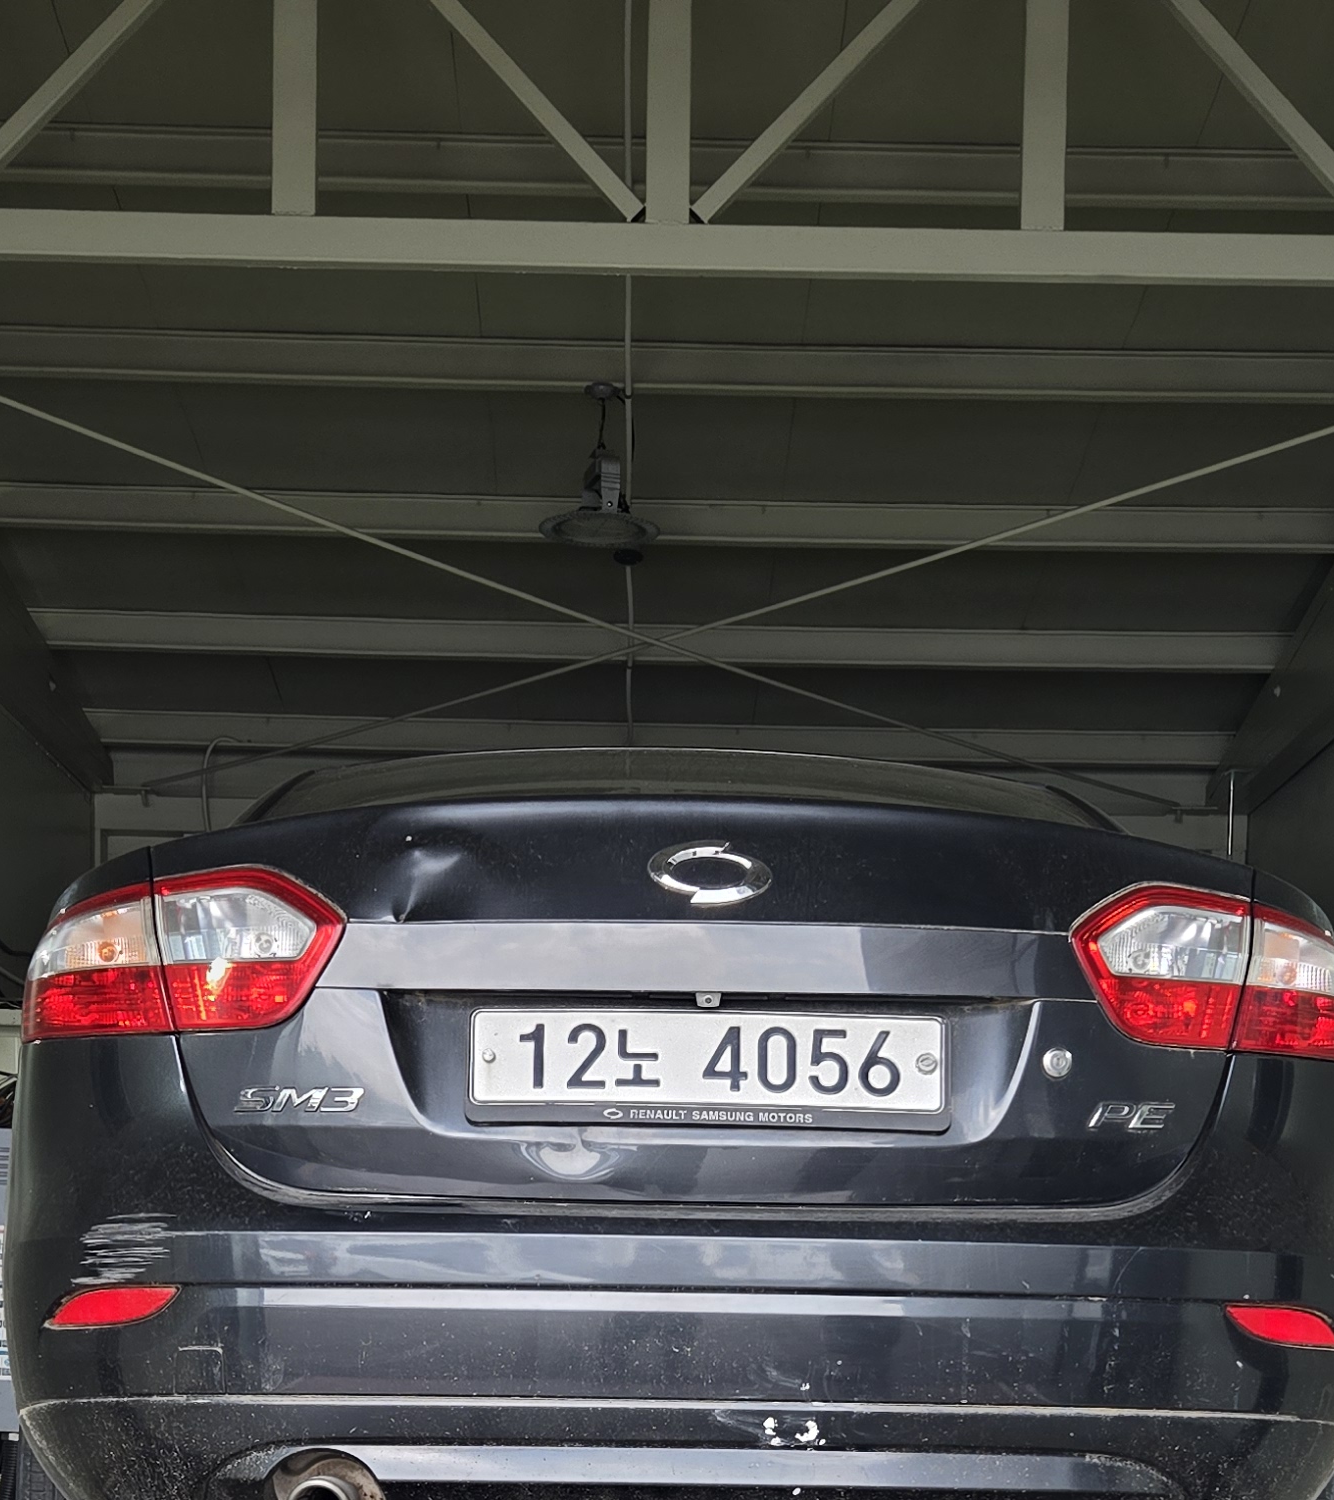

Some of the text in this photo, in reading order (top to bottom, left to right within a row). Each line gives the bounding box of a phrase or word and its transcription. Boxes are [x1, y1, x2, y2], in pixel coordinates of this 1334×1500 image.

[518, 1023, 902, 1098] 12노 4056
[234, 1085, 365, 1113] SM3
[629, 1109, 813, 1123] RENAULT SAMSUNG MOTORS
[1087, 1101, 1176, 1130] PE
